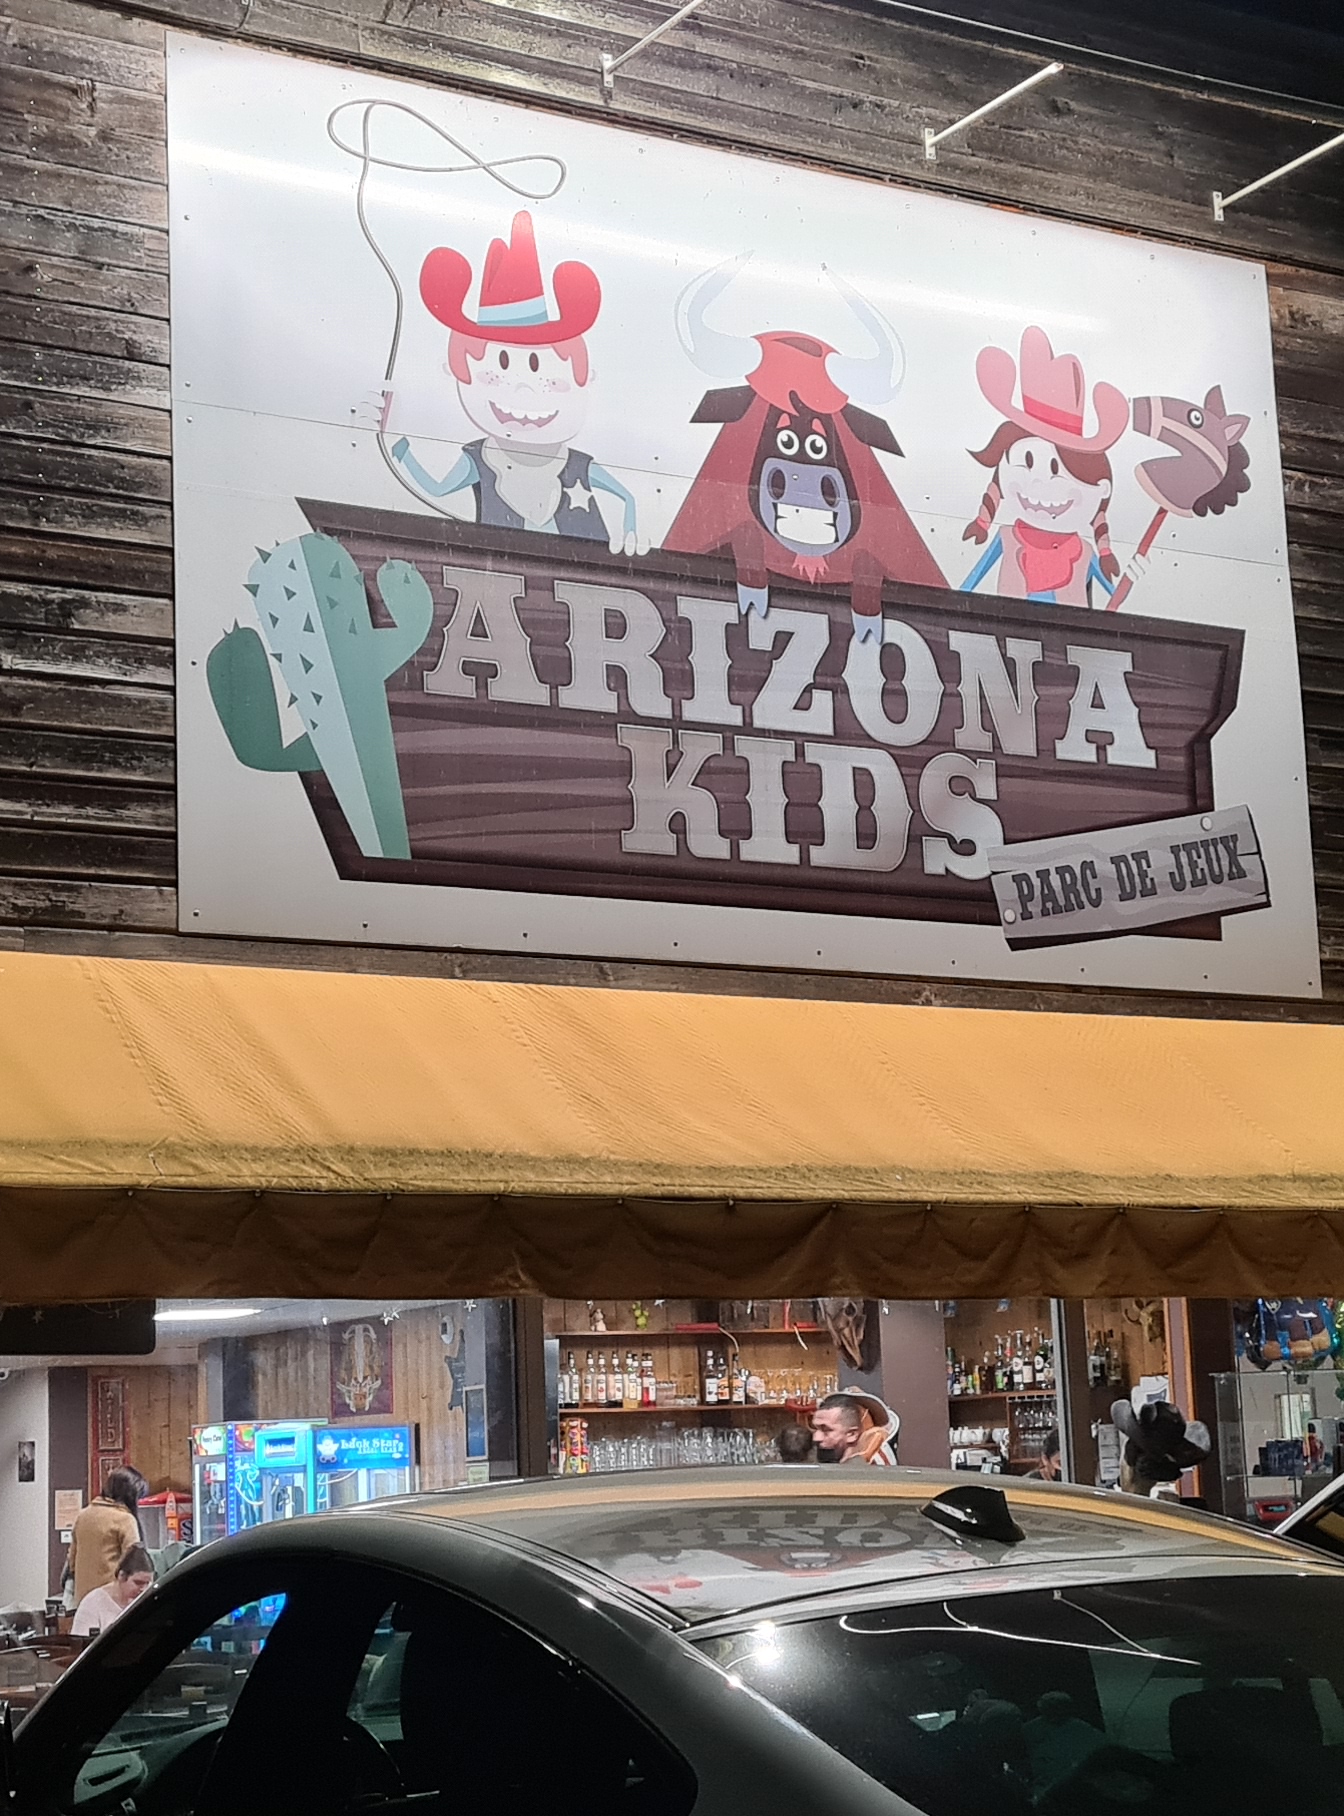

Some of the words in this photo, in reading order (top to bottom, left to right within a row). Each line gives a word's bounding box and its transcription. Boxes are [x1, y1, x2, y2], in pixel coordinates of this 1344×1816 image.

[423, 565, 1159, 769] ARIZONA
[616, 723, 1005, 881] KIDS
[1012, 860, 1102, 920] PARC
[1110, 850, 1157, 901] DE
[1168, 833, 1247, 891] JEUX
